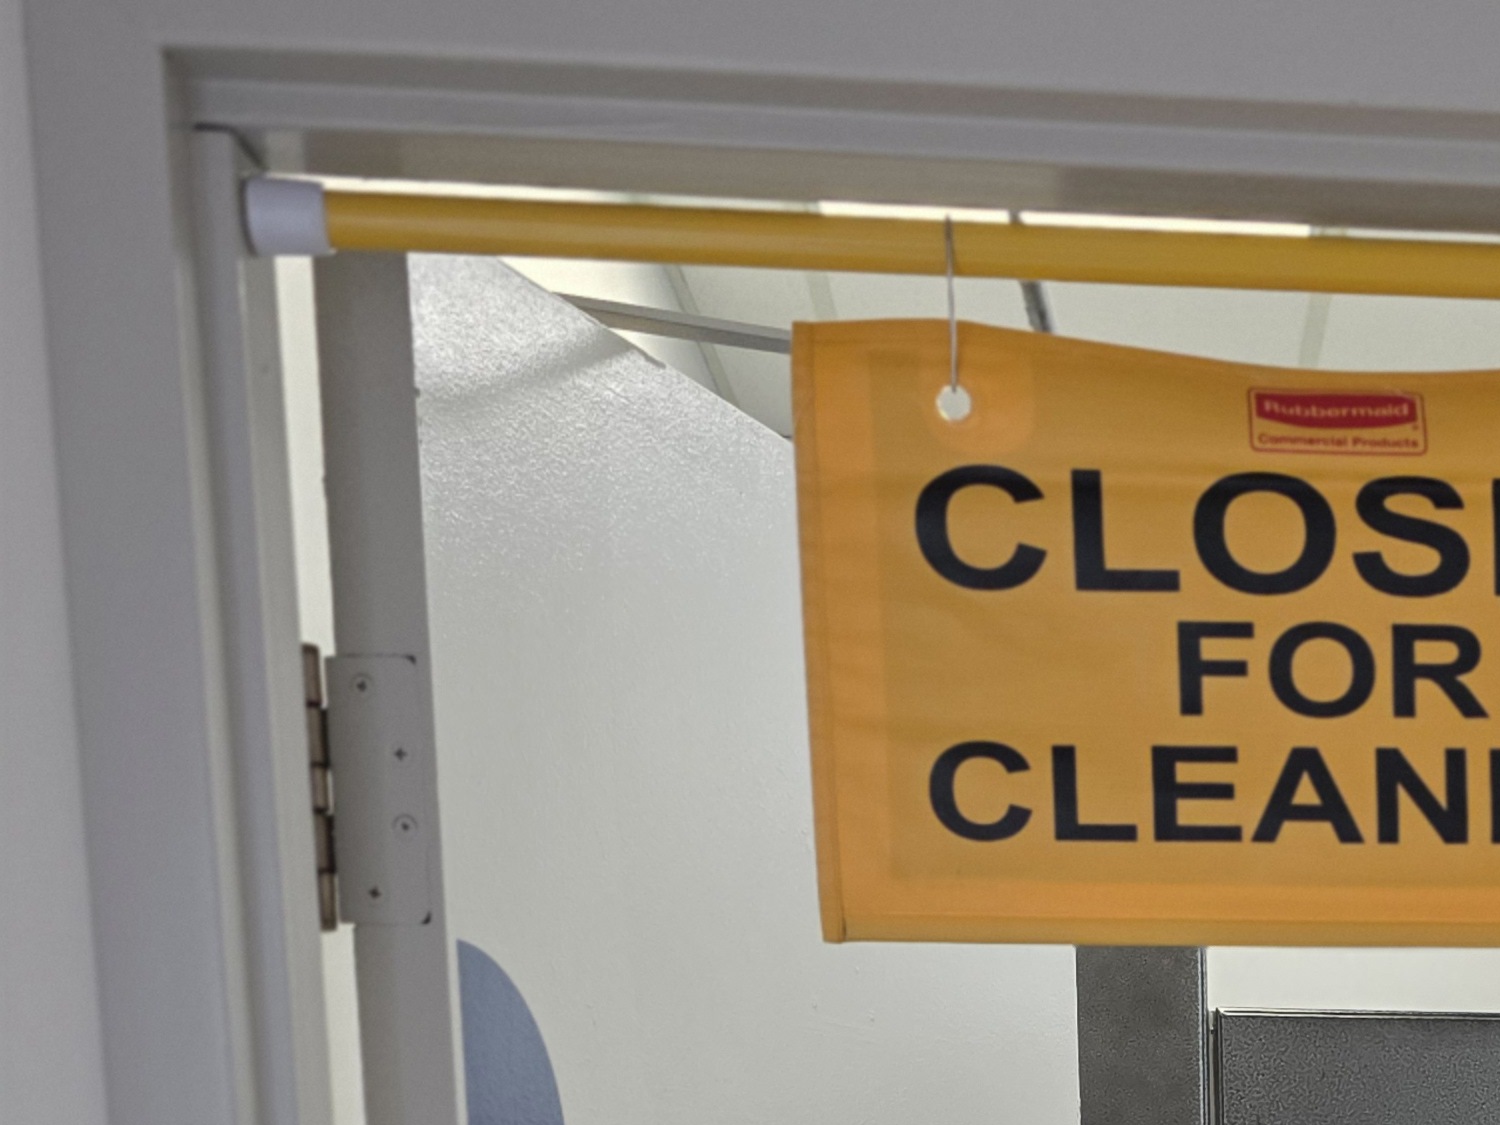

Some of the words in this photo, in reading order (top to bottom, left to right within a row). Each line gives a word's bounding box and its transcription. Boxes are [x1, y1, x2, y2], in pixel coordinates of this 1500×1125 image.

[1263, 400, 1409, 418] Rubbermaid
[1257, 433, 1348, 447] Commercial
[1352, 436, 1419, 449] Products
[1177, 621, 1488, 719] FOR
